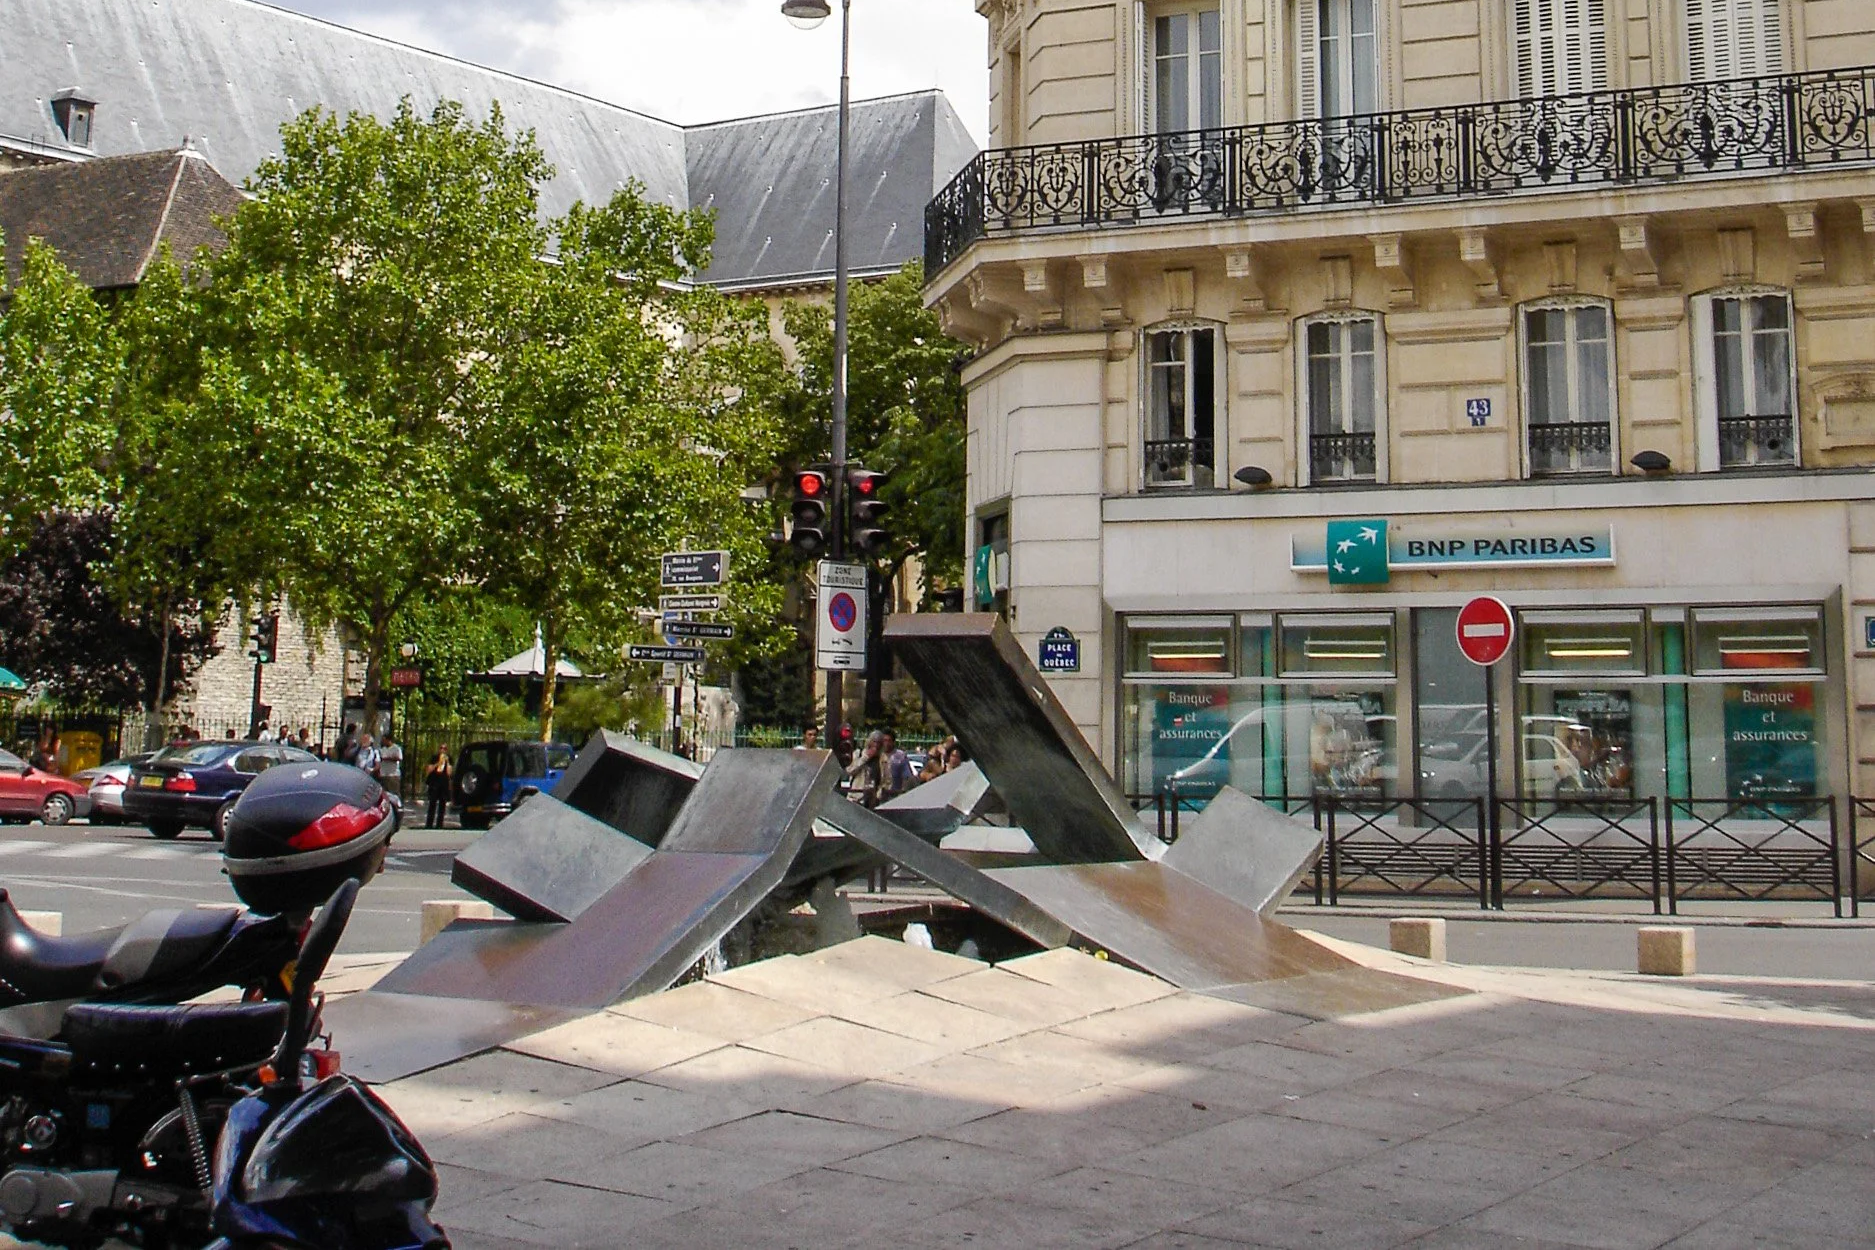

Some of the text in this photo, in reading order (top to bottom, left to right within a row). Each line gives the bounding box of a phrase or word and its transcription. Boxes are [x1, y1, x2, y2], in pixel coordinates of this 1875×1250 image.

[1469, 399, 1489, 416] 43
[1408, 536, 1596, 557] BNP PARIBAS
[834, 566, 852, 576] ZONE
[822, 575, 864, 586] TOURISTIQUE
[1047, 643, 1072, 652] PLACE
[1168, 691, 1213, 707] Banque
[1743, 690, 1793, 705] Banque
[1184, 711, 1197, 724] et
[1762, 710, 1776, 724] et
[1159, 726, 1223, 740] assurances
[1733, 729, 1807, 741] assurances
